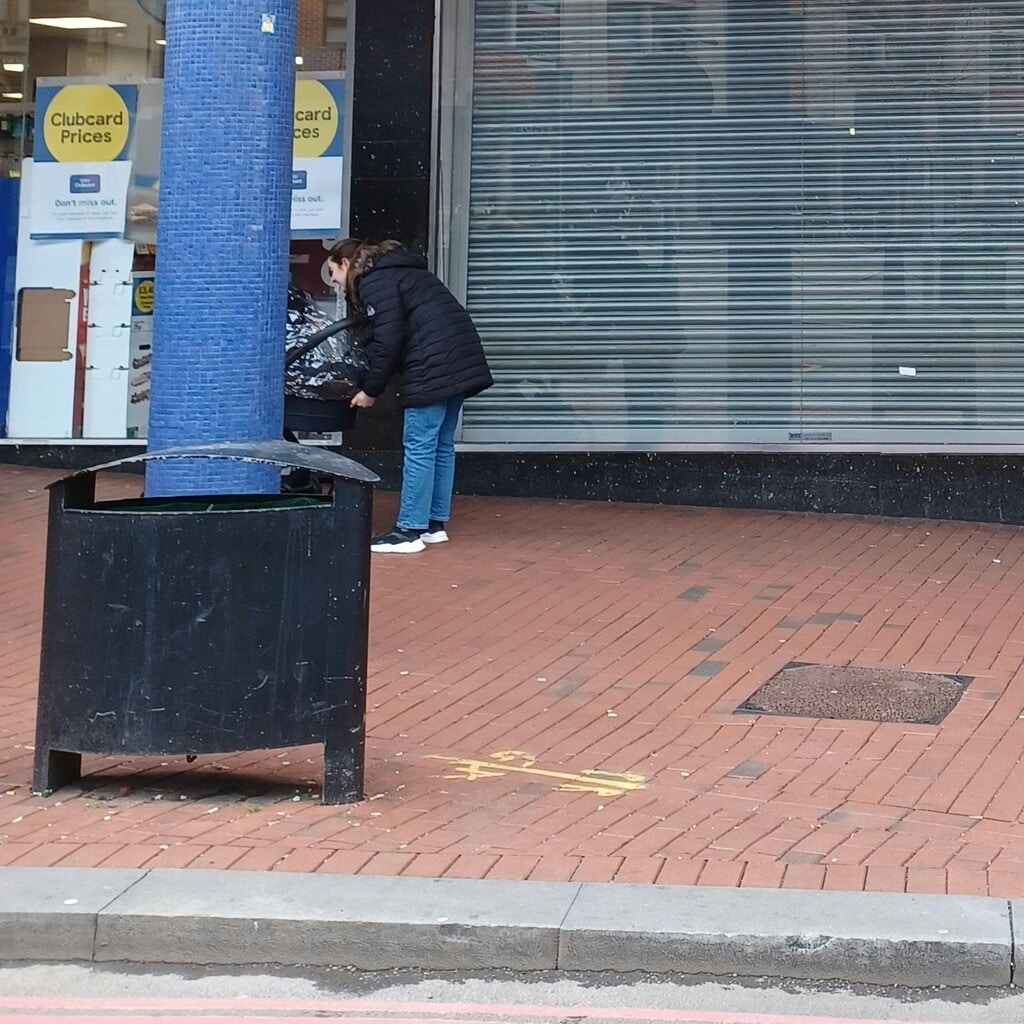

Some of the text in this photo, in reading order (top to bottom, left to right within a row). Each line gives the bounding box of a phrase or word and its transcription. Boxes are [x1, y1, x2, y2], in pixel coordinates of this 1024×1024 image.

[51, 111, 123, 126] Clubcard
[295, 107, 331, 121] card
[61, 129, 112, 144] Prices
[292, 127, 320, 140] ces
[54, 198, 76, 207] Don't
[79, 198, 98, 207] miss
